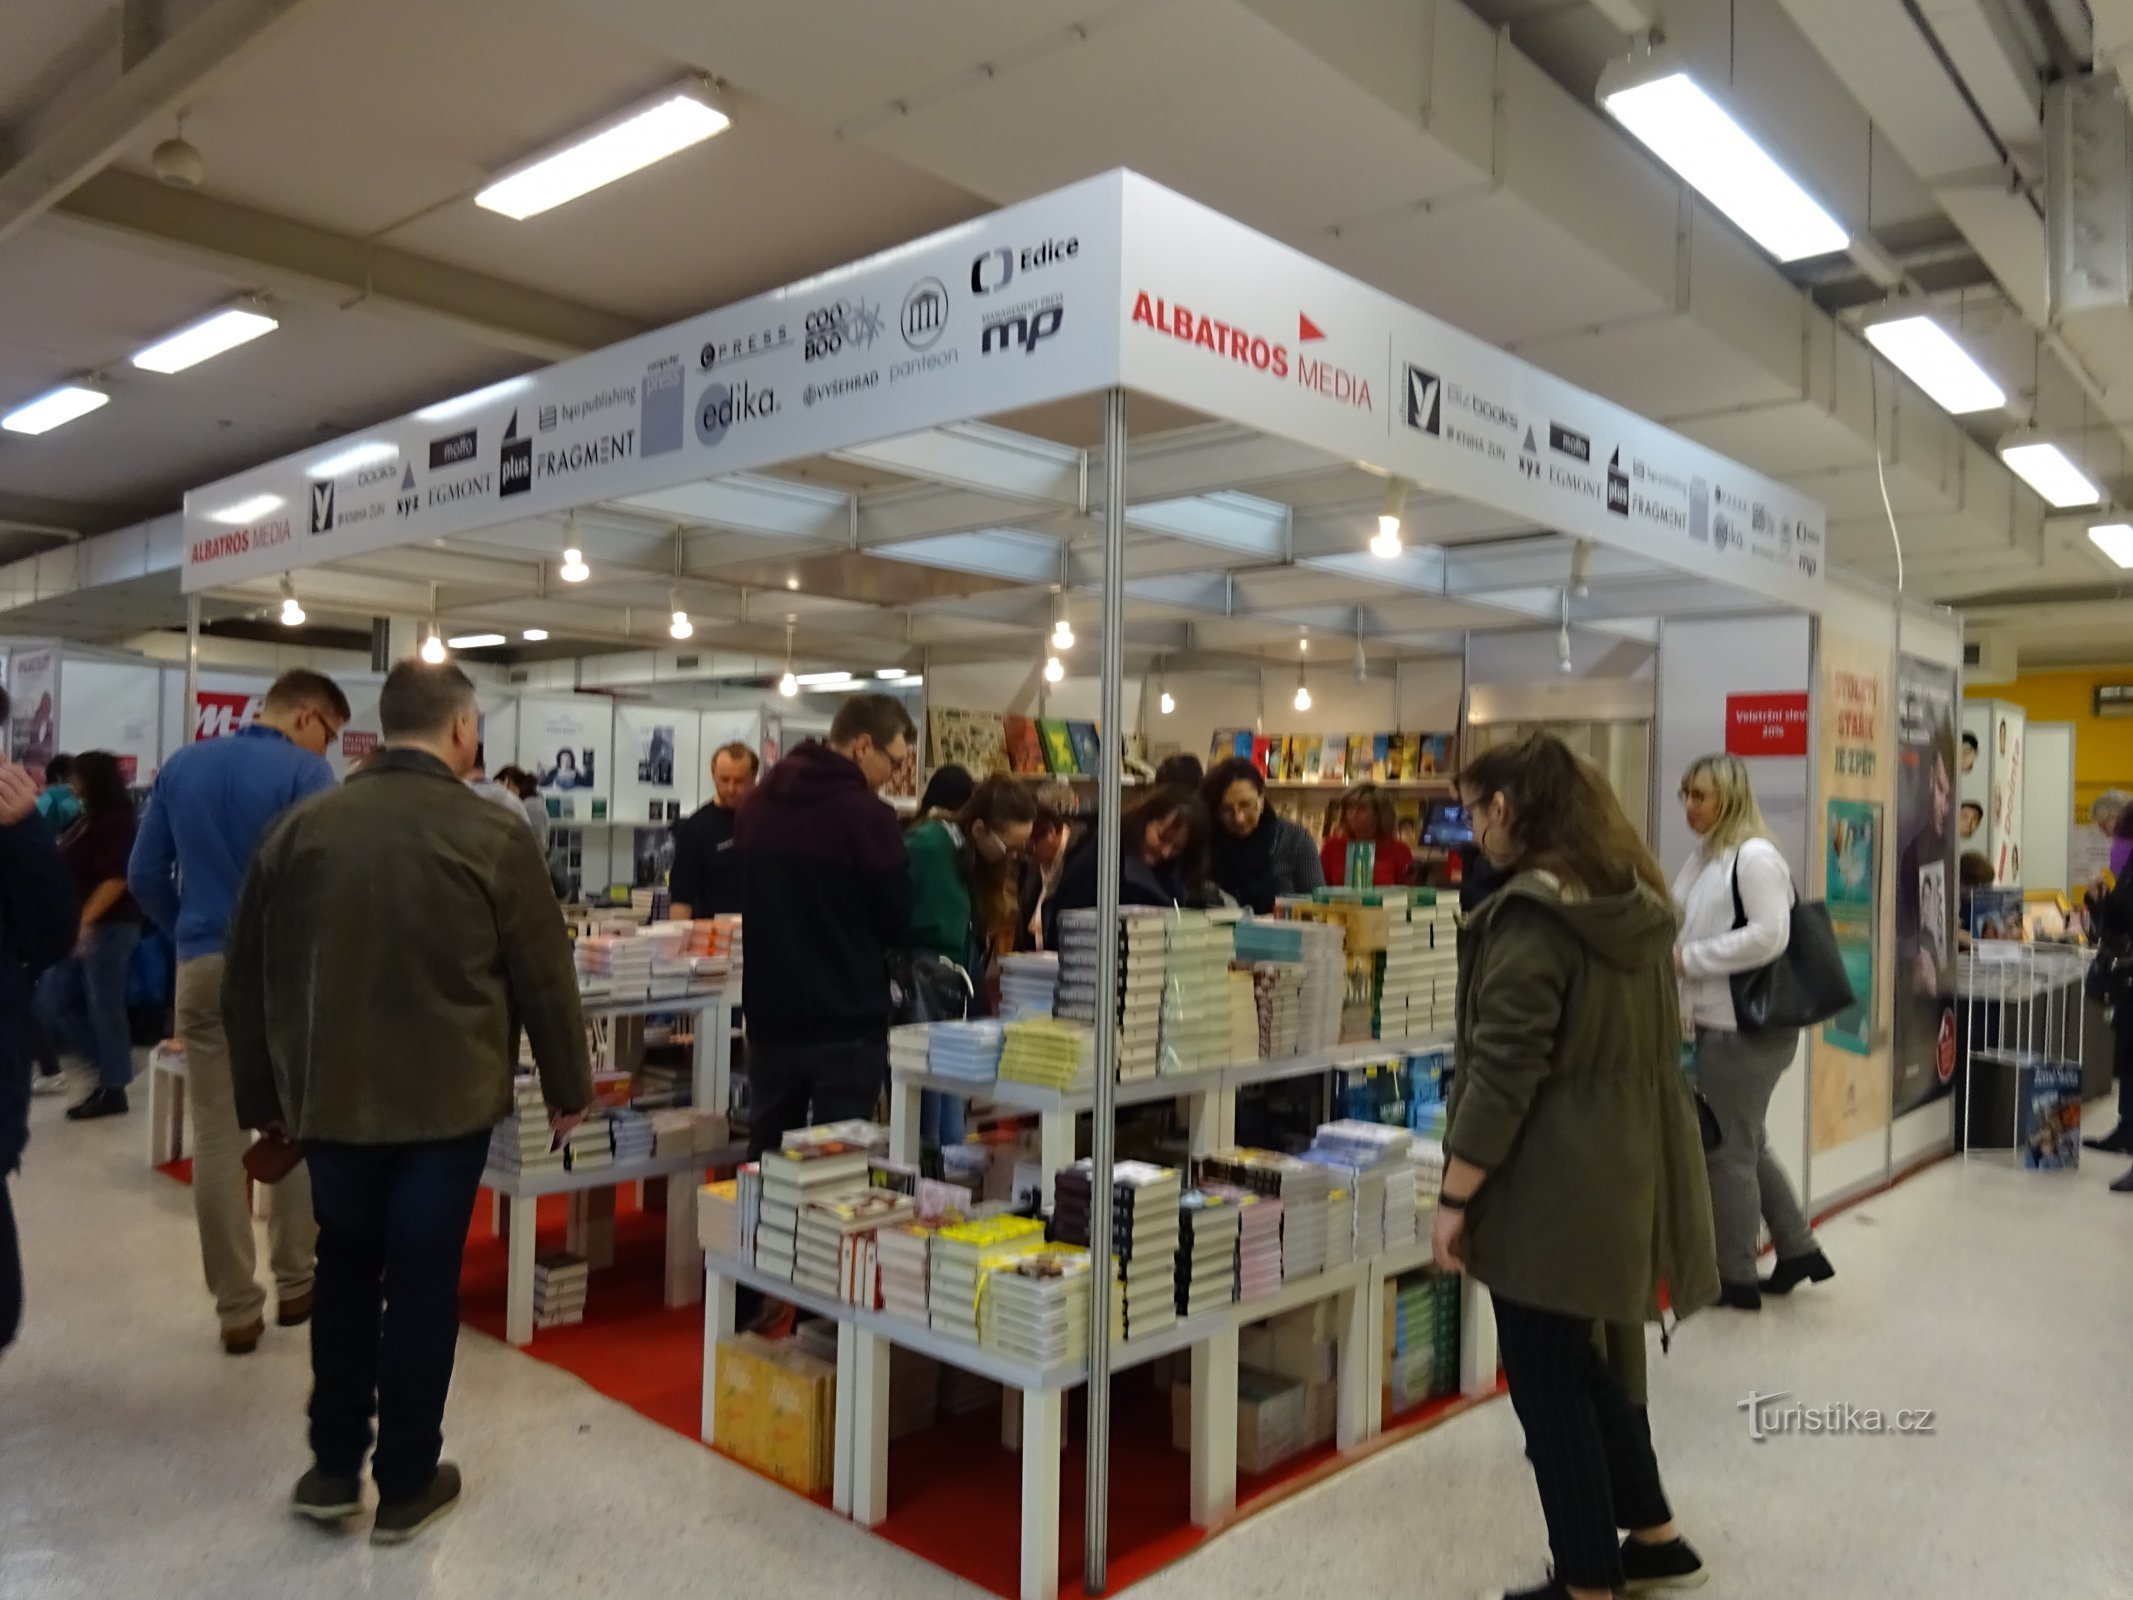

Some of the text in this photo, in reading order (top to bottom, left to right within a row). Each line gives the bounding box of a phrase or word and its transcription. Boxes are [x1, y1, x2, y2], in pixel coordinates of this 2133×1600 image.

[1020, 237, 1078, 273] Edice
[805, 331, 842, 362] BOO
[982, 305, 1063, 356] mp
[889, 347, 958, 386] panteon
[1133, 290, 1288, 378] ALBATROS
[1298, 353, 1372, 412] MEDIA
[582, 386, 637, 420] publishing
[502, 455, 530, 487] plus
[537, 428, 635, 480] FRAGMENT
[428, 472, 494, 508] EGMONT
[1549, 463, 1600, 501] EGMONT
[1608, 478, 1628, 507] plus
[1632, 492, 1686, 531] FRAGMENT
[192, 518, 291, 565] ALBATROS MEDIA
[1785, 706, 1808, 723] slev
